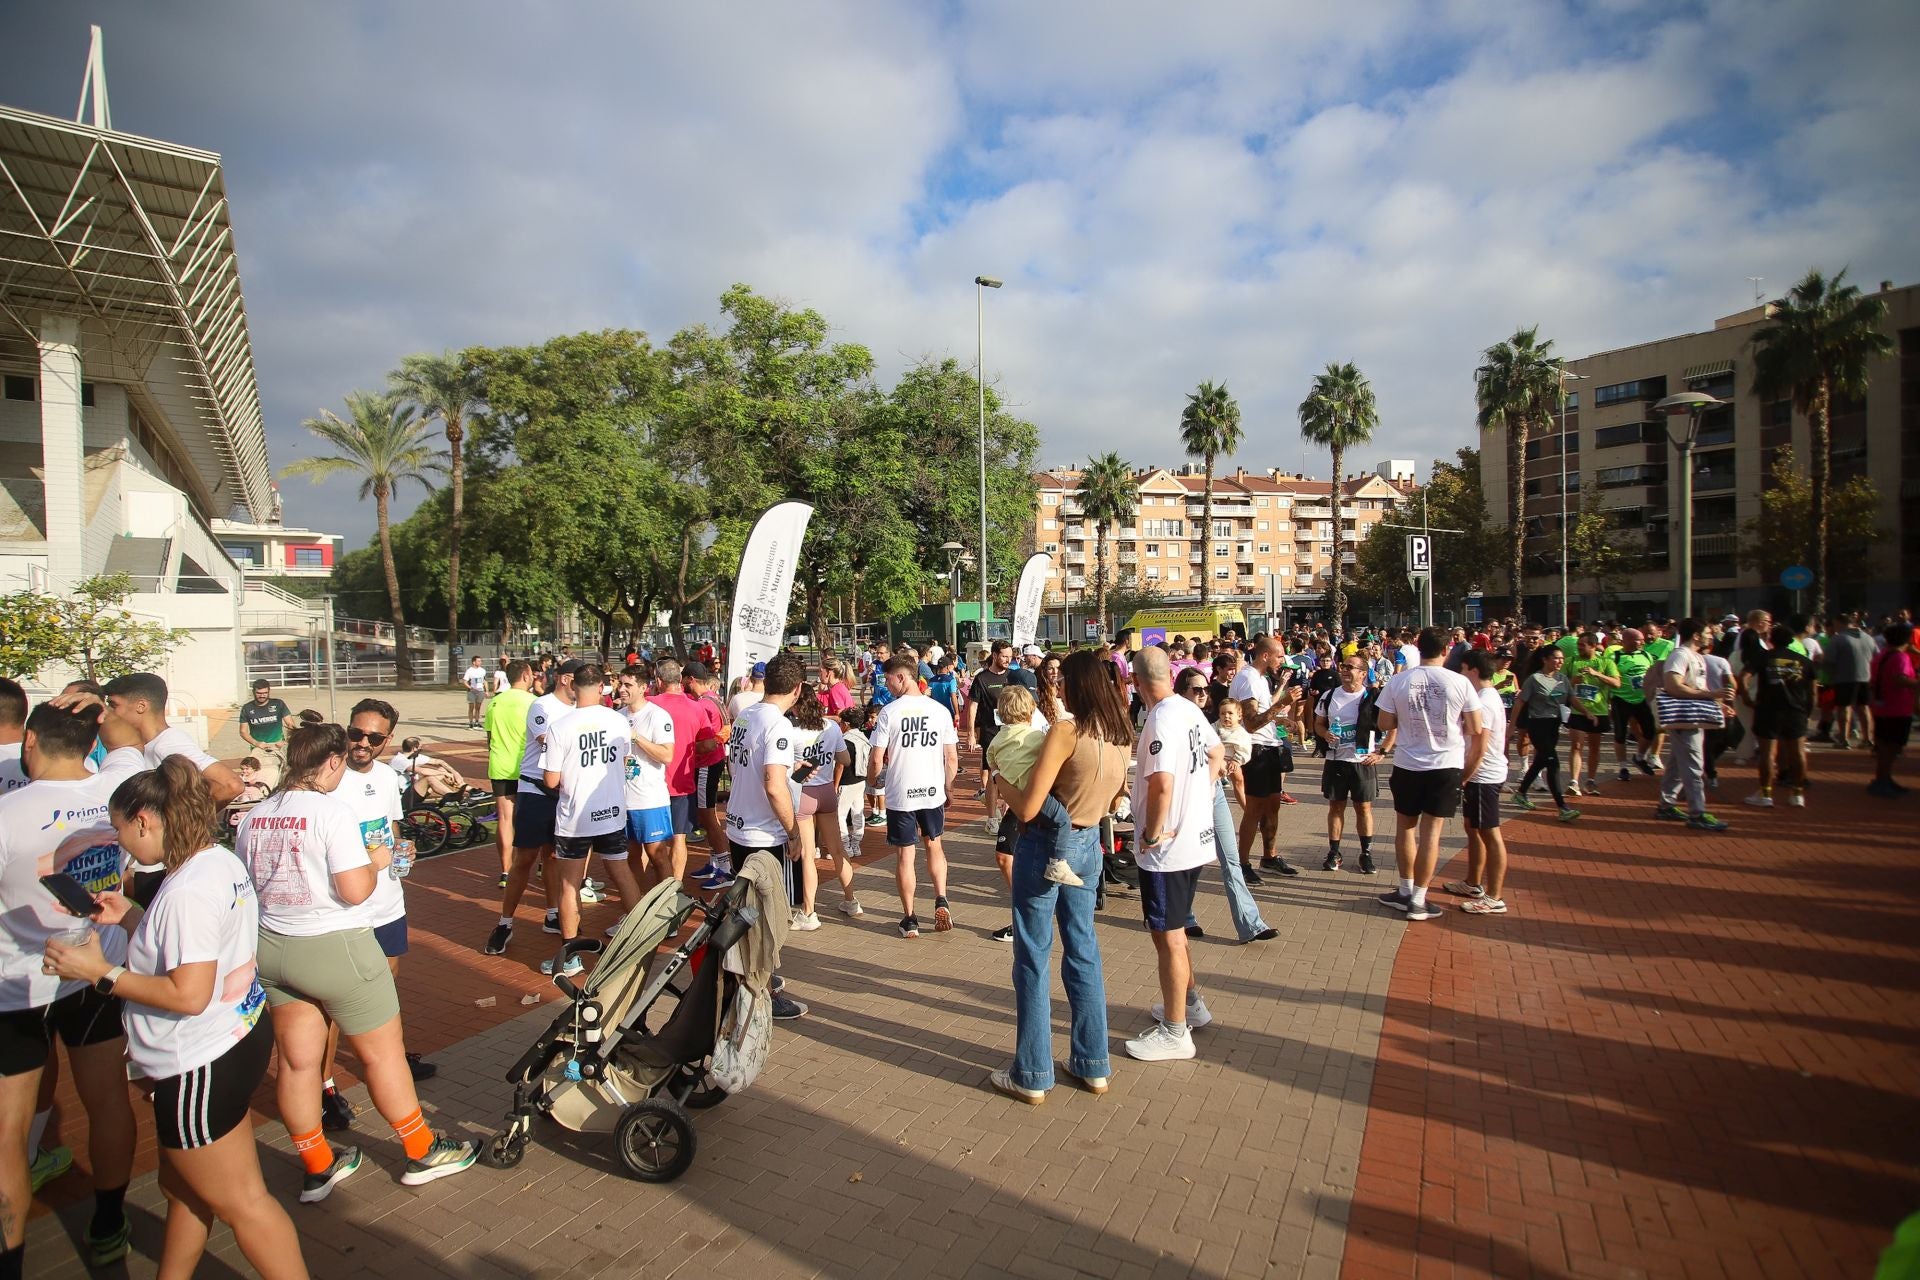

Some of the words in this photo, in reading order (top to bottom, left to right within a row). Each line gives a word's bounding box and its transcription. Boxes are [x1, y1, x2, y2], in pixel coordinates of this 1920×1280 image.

[1413, 537, 1426, 565] P
[756, 540, 778, 603] Ayuntamiento
[771, 558, 786, 595] Murcia
[768, 596, 776, 607] de
[901, 716, 929, 732] ONE
[579, 730, 607, 750] ONE
[730, 726, 747, 746] ONE
[901, 732, 919, 748] OF
[921, 731, 938, 747] US
[581, 749, 598, 768] OF
[601, 746, 617, 764] US
[729, 745, 739, 764] OF
[803, 741, 825, 758] ONE
[818, 752, 833, 767] US
[67, 805, 109, 820] Prima
[249, 817, 307, 831] MURCIA
[86, 872, 120, 893] TURO
